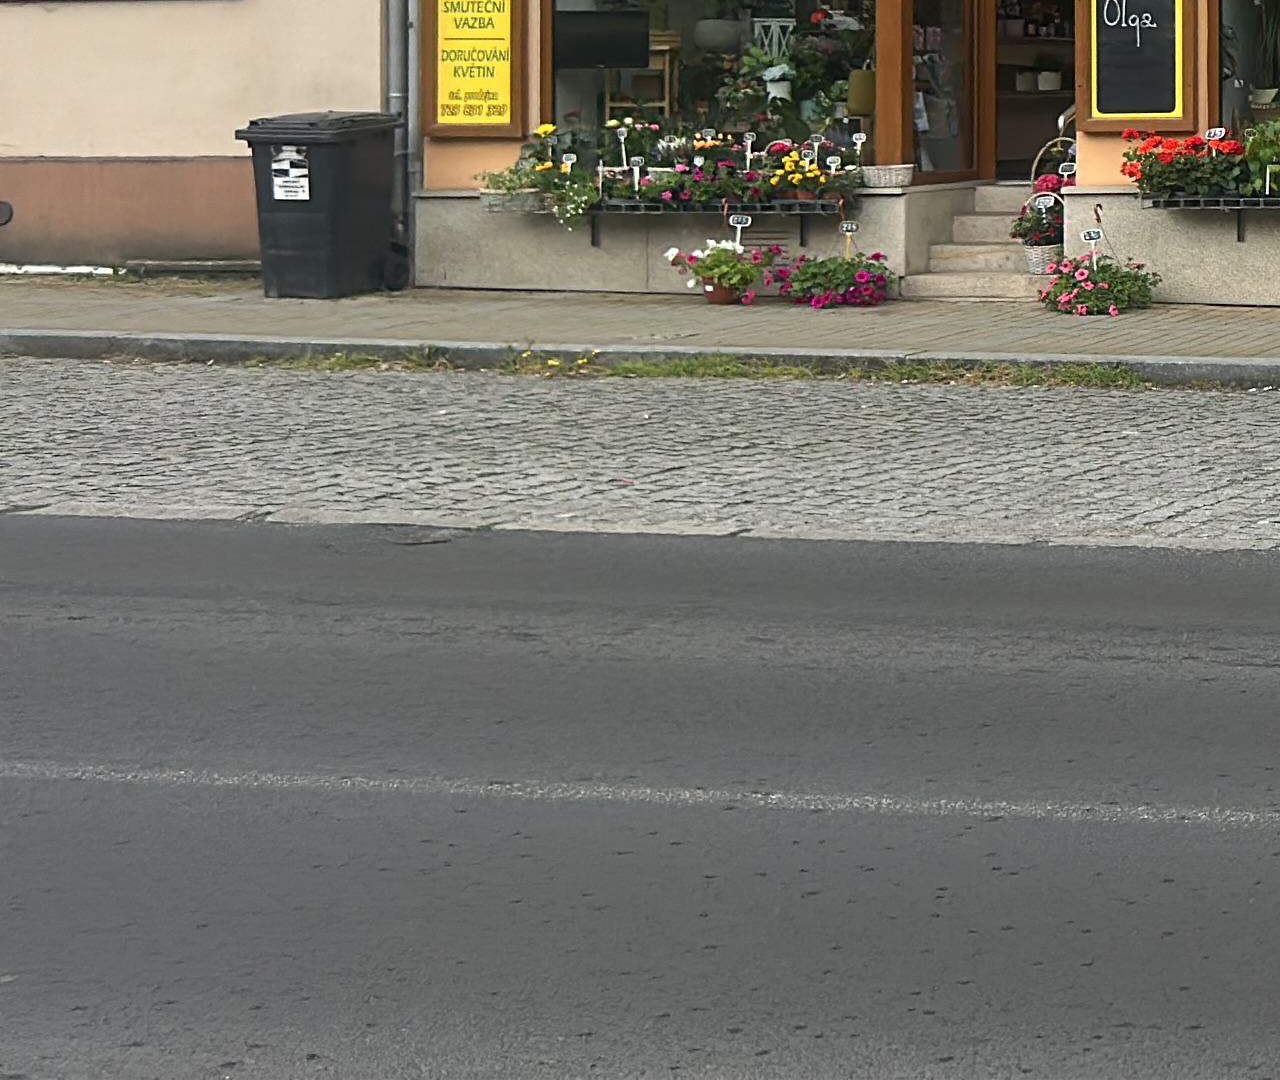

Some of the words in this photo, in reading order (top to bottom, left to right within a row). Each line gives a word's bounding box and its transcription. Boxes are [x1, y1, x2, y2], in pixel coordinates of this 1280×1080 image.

[454, 18, 495, 29] VAZBA
[441, 47, 510, 62] DORUČOVÁNÍ
[453, 63, 495, 78] KVĚTIN
